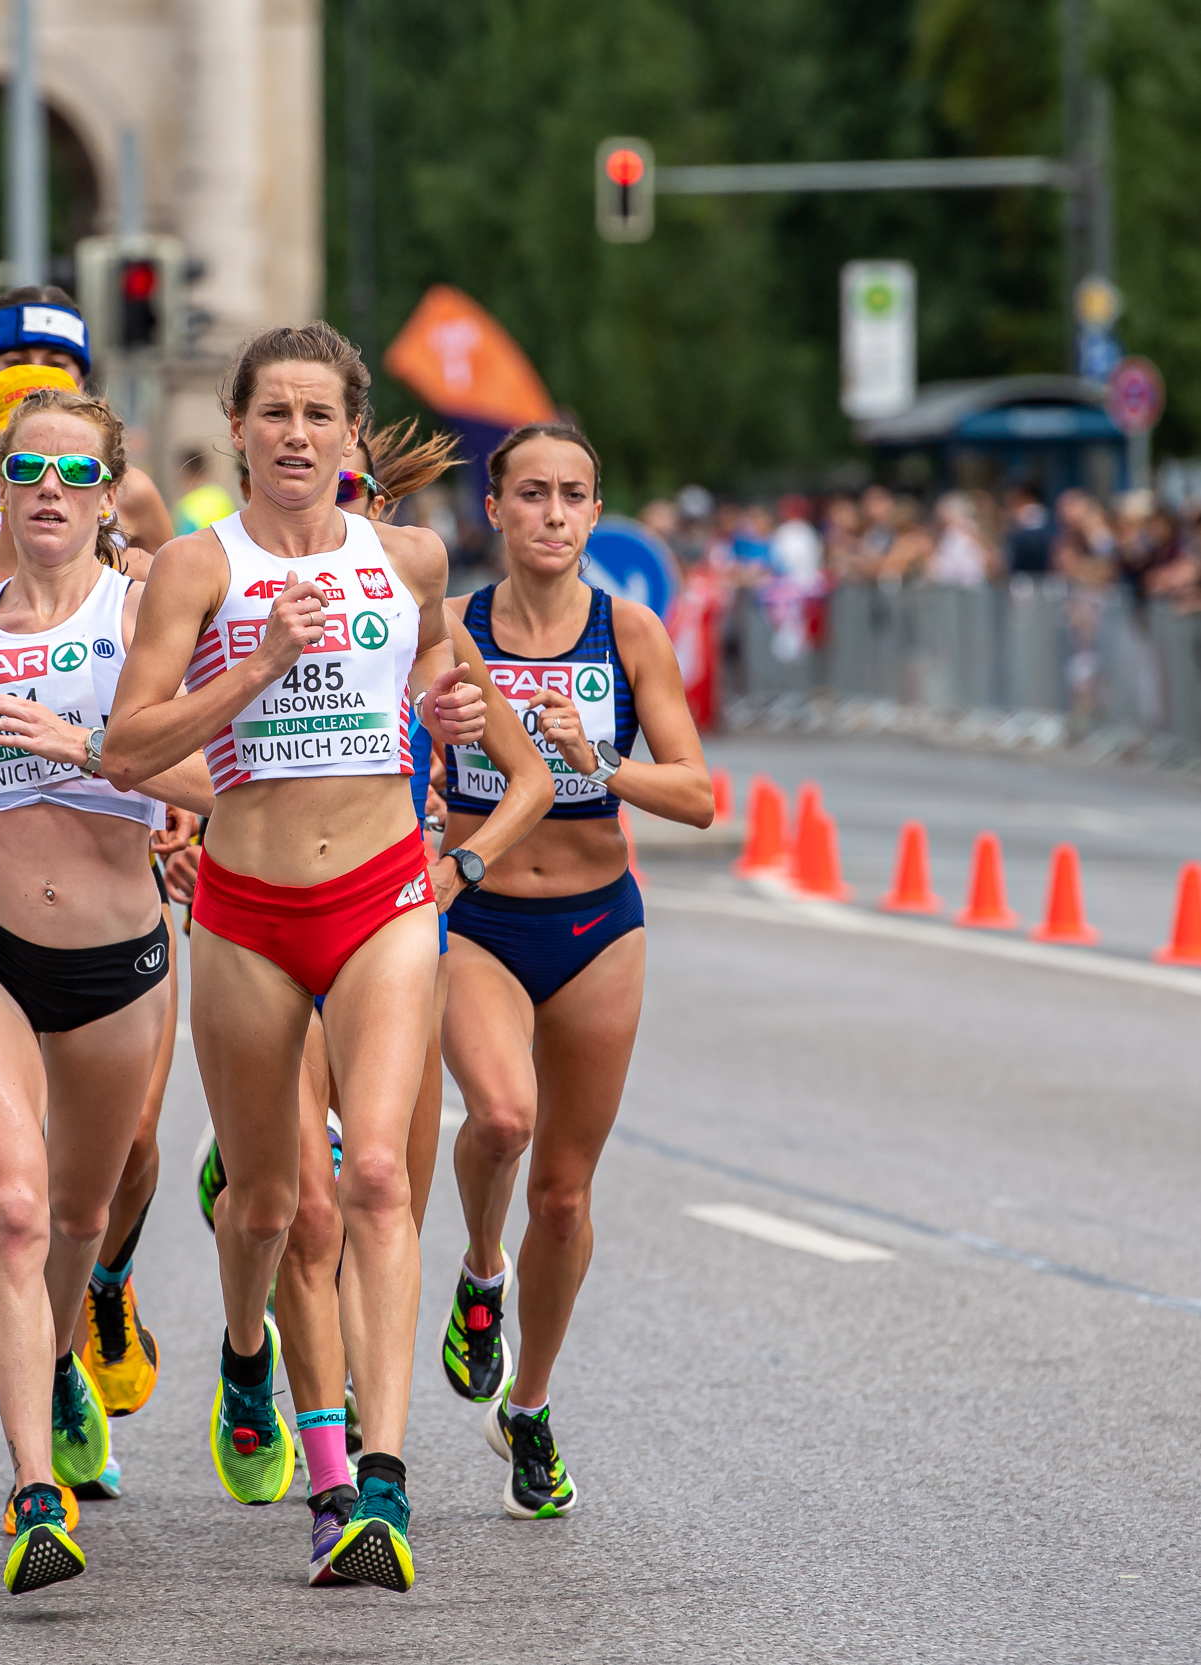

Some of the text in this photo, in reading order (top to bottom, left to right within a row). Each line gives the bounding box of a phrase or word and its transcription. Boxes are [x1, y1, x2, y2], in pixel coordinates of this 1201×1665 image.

[244, 580, 286, 599] 4F
[232, 619, 347, 653] SR
[282, 662, 344, 693] 485
[490, 669, 569, 696] PAR
[262, 692, 366, 715] LISOWSKA
[268, 722, 272, 735] I
[276, 719, 308, 733] RUN
[242, 734, 391, 763] MUNICH 2022
[46, 760, 80, 776] 20
[395, 871, 427, 907] 4F
